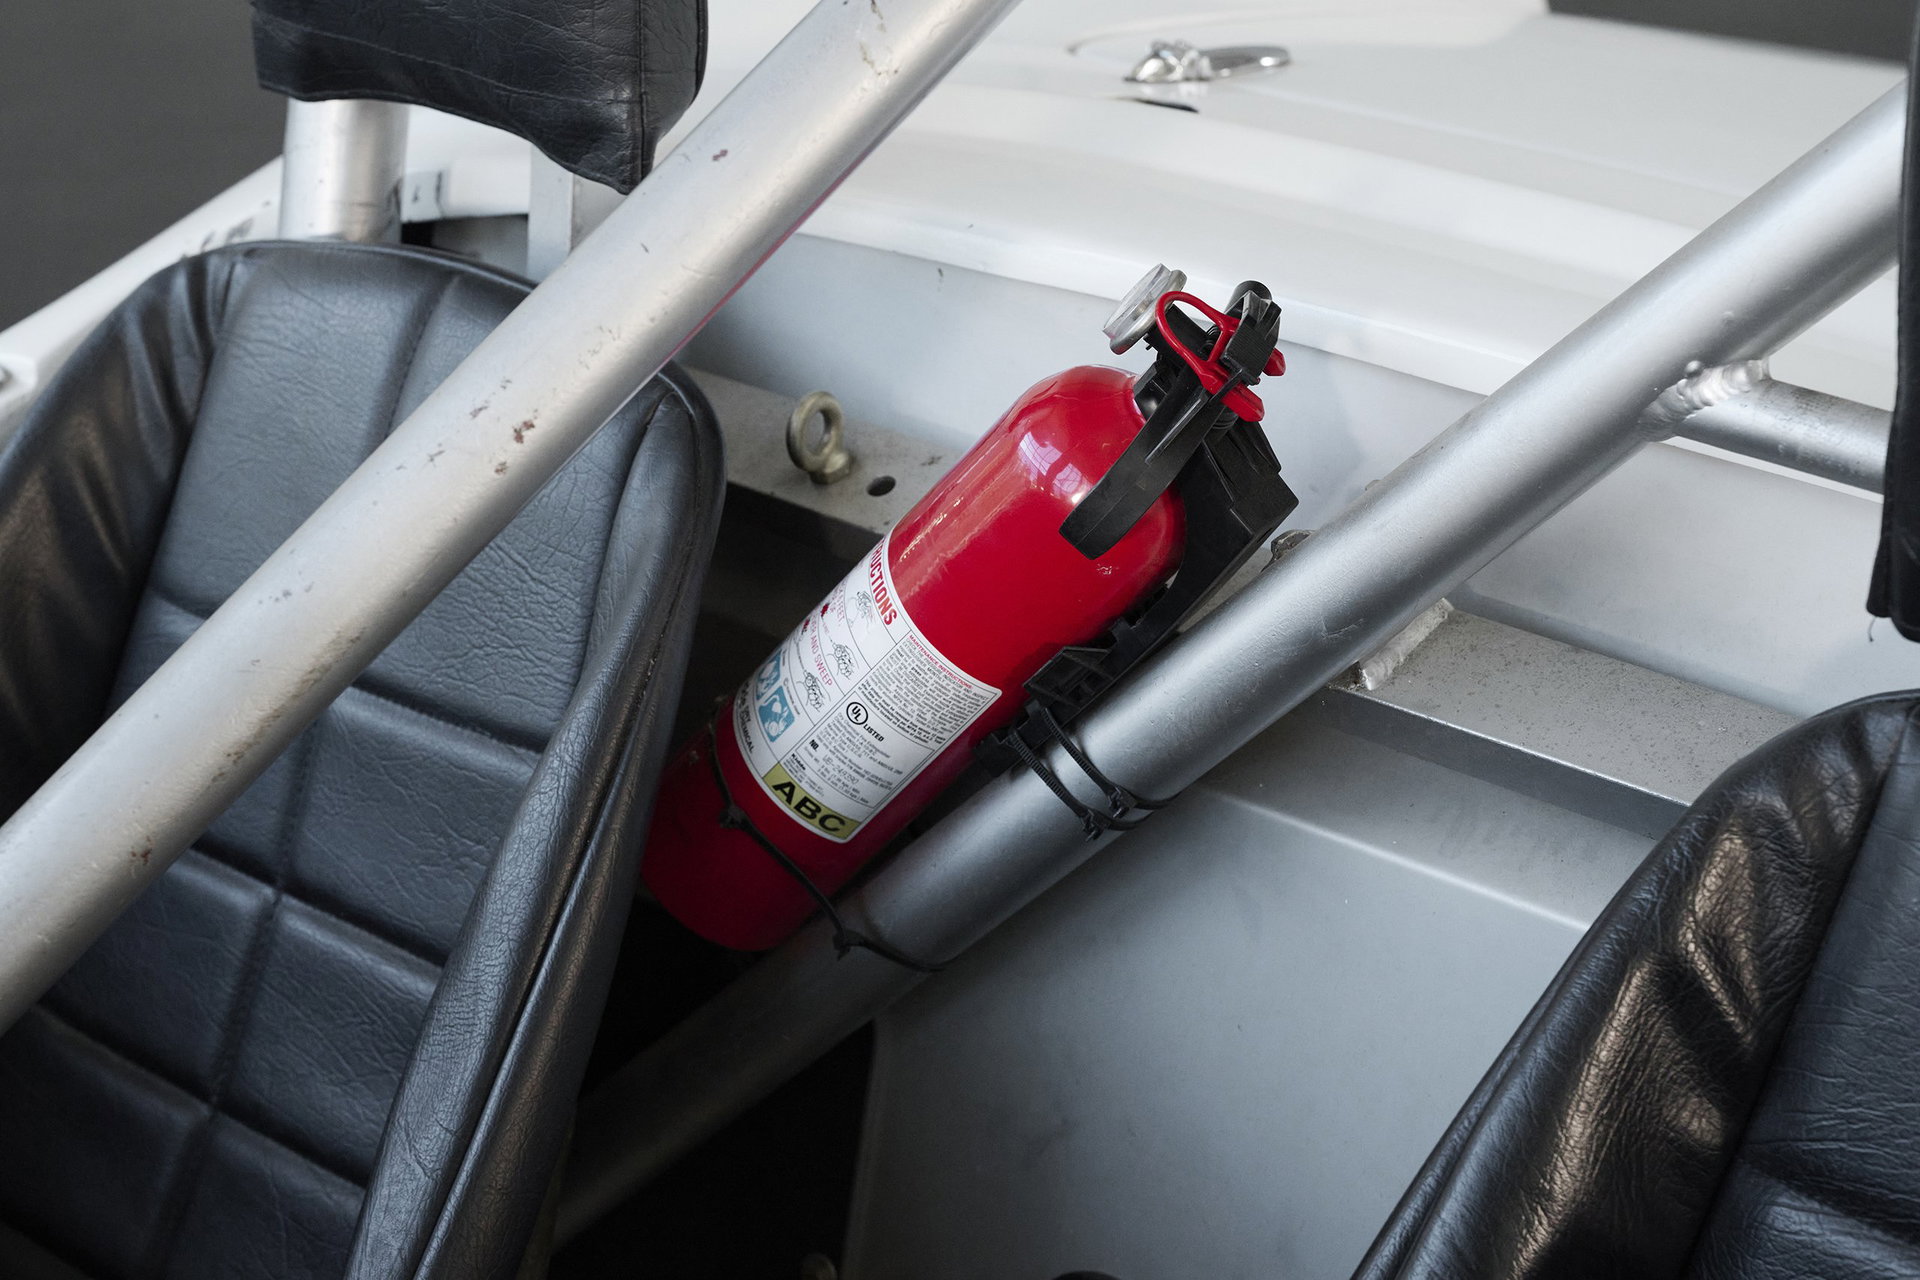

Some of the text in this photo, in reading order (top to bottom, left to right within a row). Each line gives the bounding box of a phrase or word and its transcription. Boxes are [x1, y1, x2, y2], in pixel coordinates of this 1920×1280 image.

[908, 634, 939, 665] MAINTENANCE
[814, 654, 833, 687] SWEEP
[862, 723, 885, 742] LISTED
[771, 781, 846, 832] ABC
